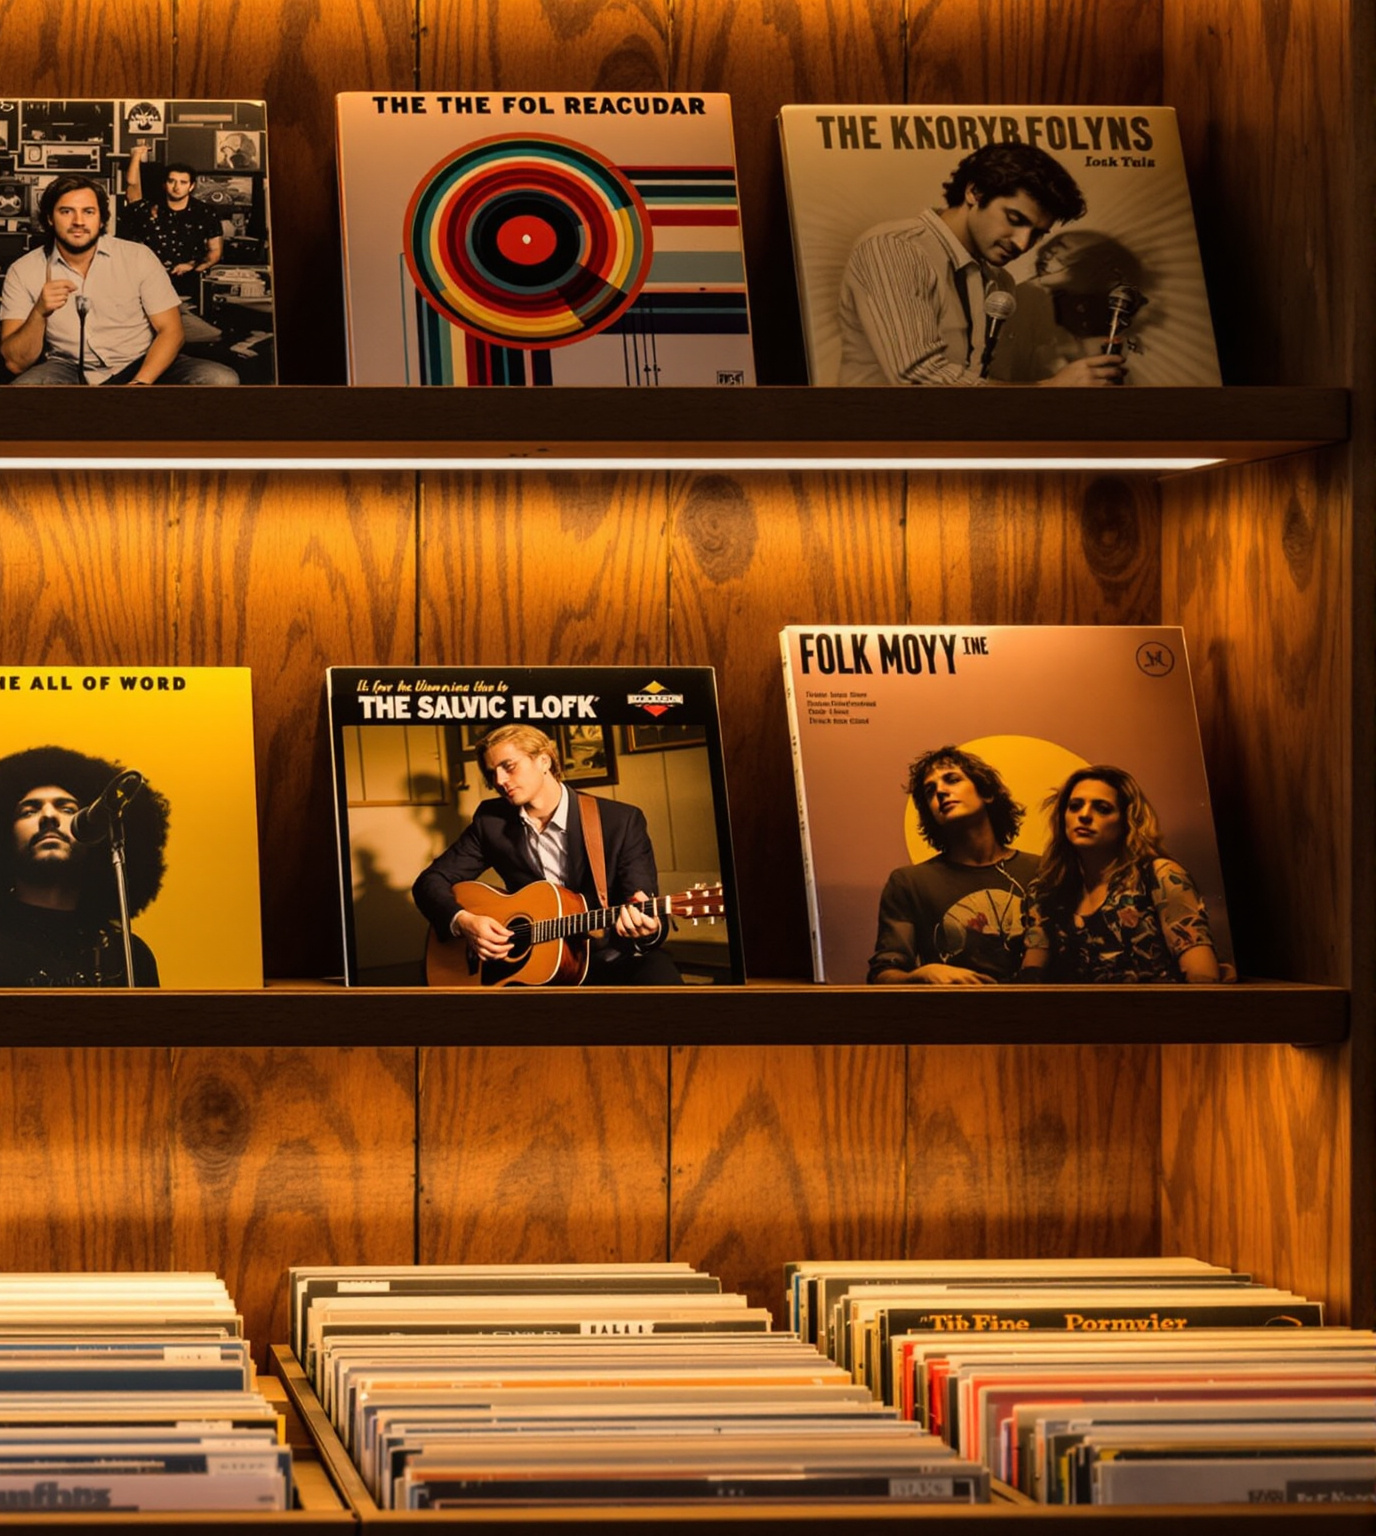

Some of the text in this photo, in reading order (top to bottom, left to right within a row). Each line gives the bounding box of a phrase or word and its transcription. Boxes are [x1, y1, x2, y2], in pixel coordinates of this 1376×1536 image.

[373, 97, 706, 115] THE THE FOL REACUDAR
[816, 116, 881, 149] THE
[799, 633, 873, 674] FOLK
[877, 634, 956, 674] MOYY
[30, 676, 72, 691] ALL
[82, 676, 110, 691] OF
[120, 676, 186, 691] WORD
[358, 696, 411, 718] THE
[417, 696, 506, 718] SALVIC
[972, 1314, 1029, 1331] Fine
